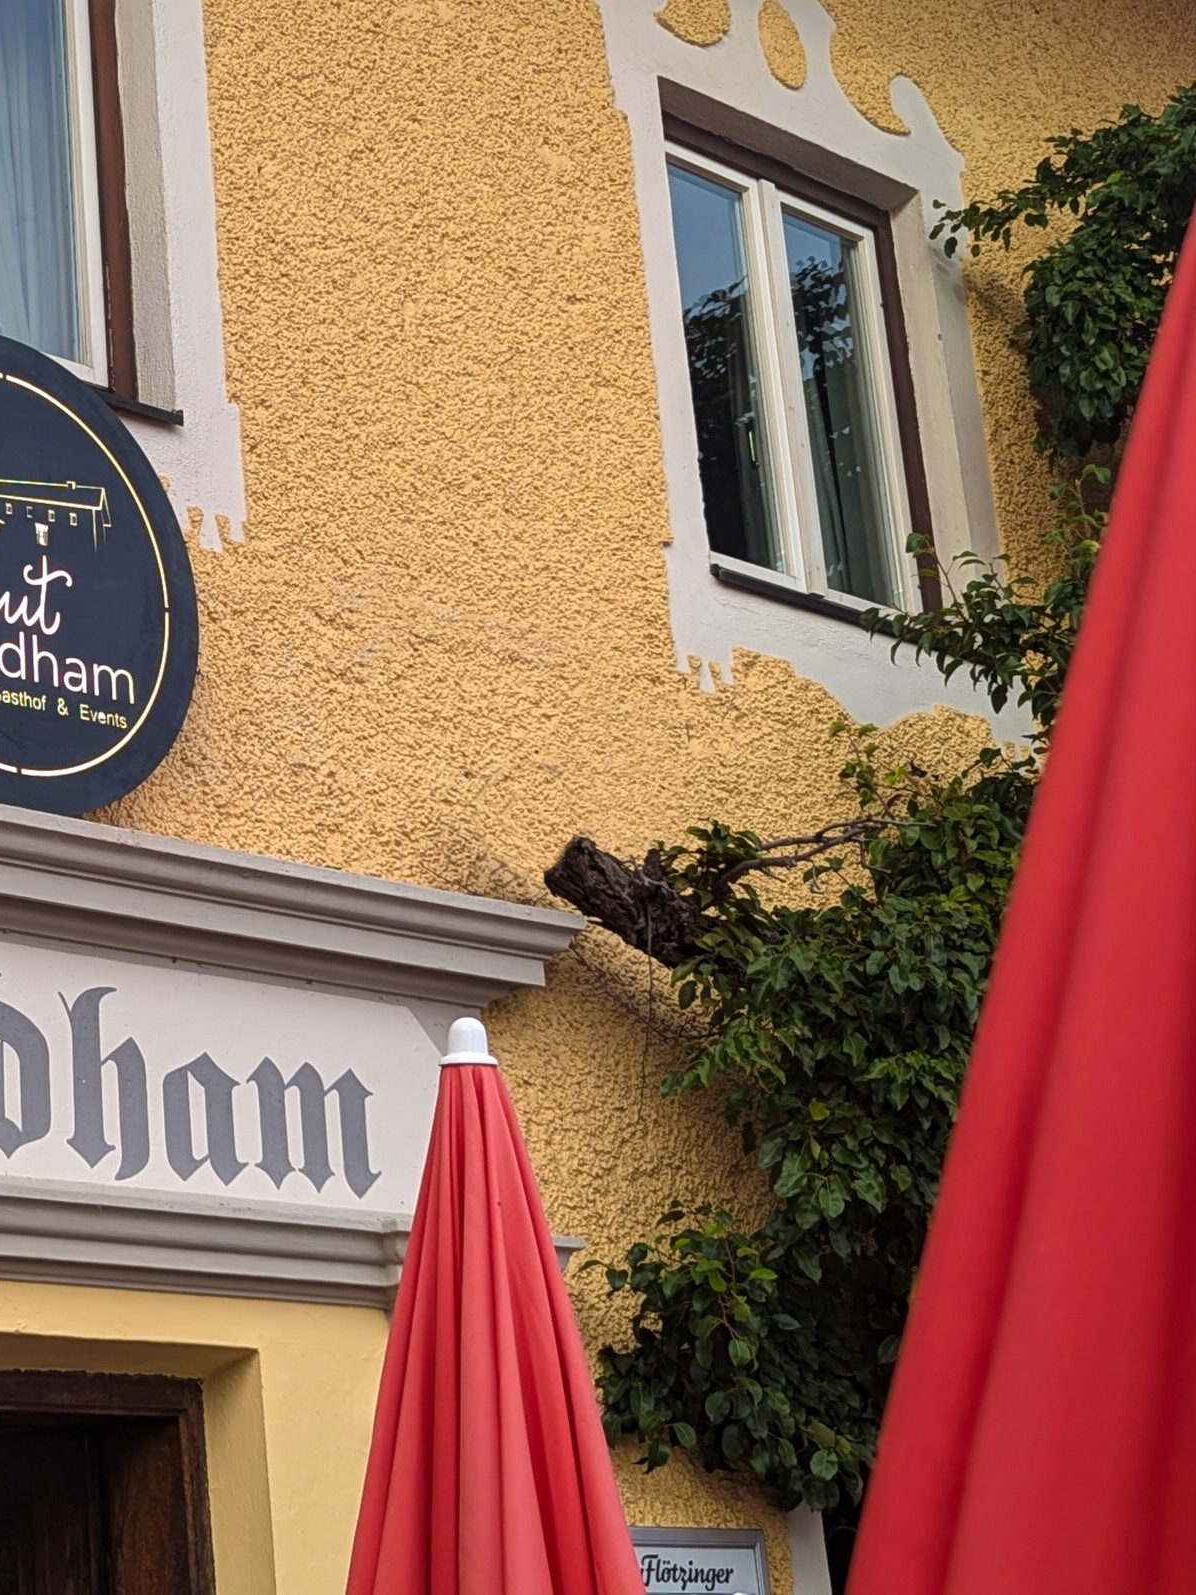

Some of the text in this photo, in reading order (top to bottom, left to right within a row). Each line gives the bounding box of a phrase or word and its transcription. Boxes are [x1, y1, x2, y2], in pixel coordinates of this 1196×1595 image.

[56, 698, 69, 716] &
[79, 703, 128, 730] Events
[640, 1554, 734, 1591] Flötzinger
